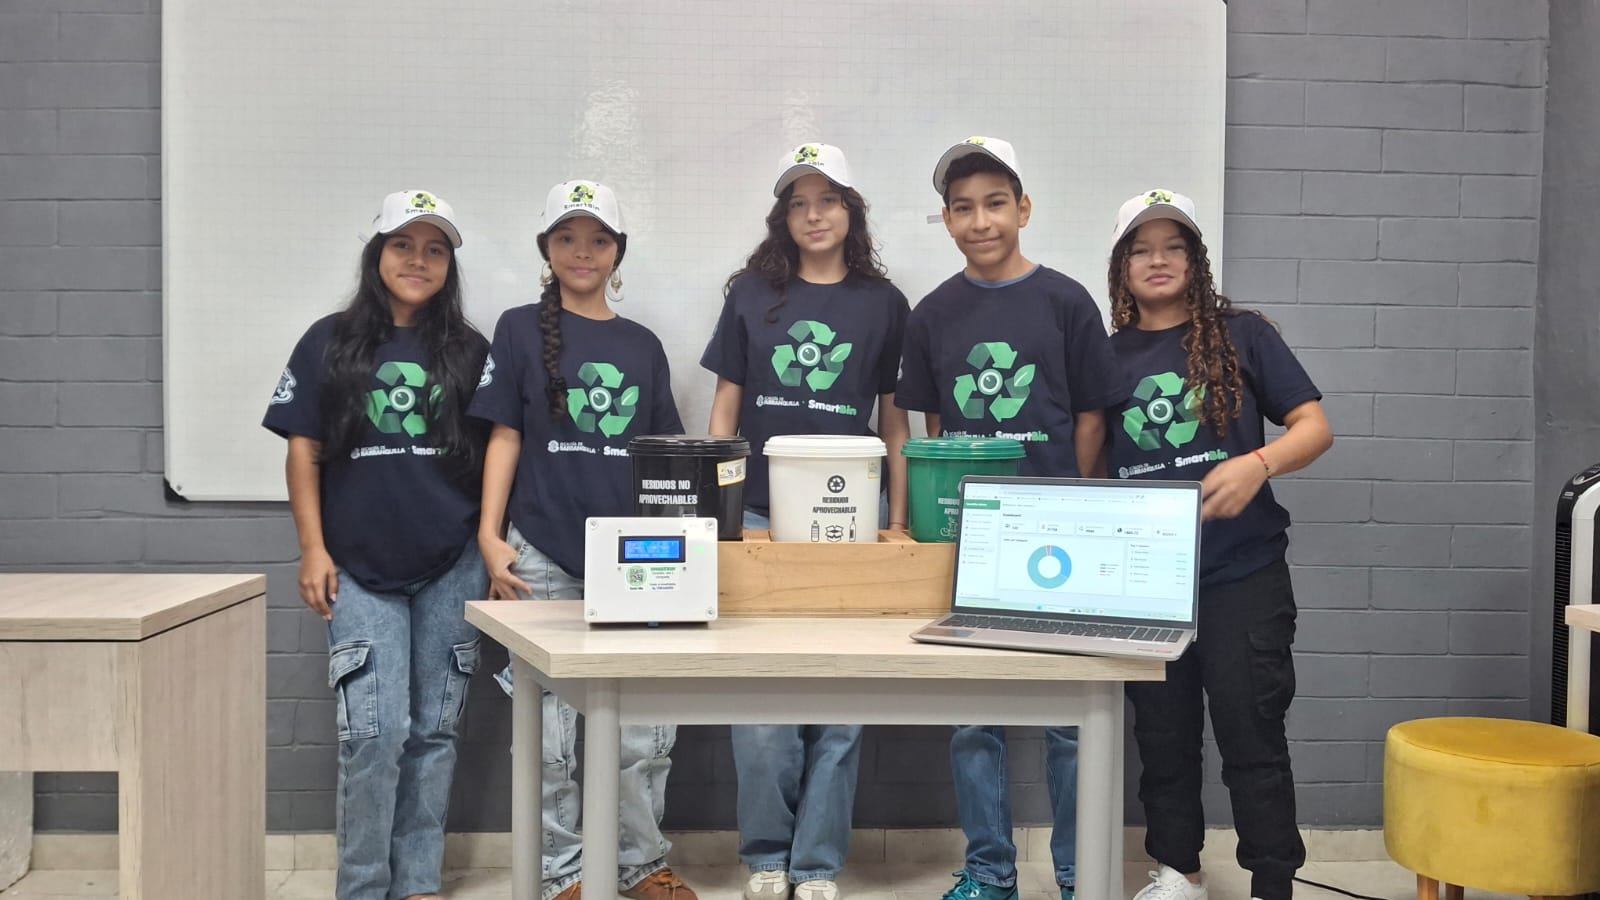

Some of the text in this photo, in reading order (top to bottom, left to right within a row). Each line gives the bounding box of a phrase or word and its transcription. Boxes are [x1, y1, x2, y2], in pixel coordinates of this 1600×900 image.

[808, 399, 857, 416] SmartBin
[995, 430, 1049, 442] SmartBin
[603, 446, 630, 457] Sma
[1175, 449, 1229, 467] SmartBin
[641, 479, 691, 490] RESIDUOS NO
[638, 494, 698, 505] APROVECHABLES
[812, 506, 857, 514] APROVECHABLES
